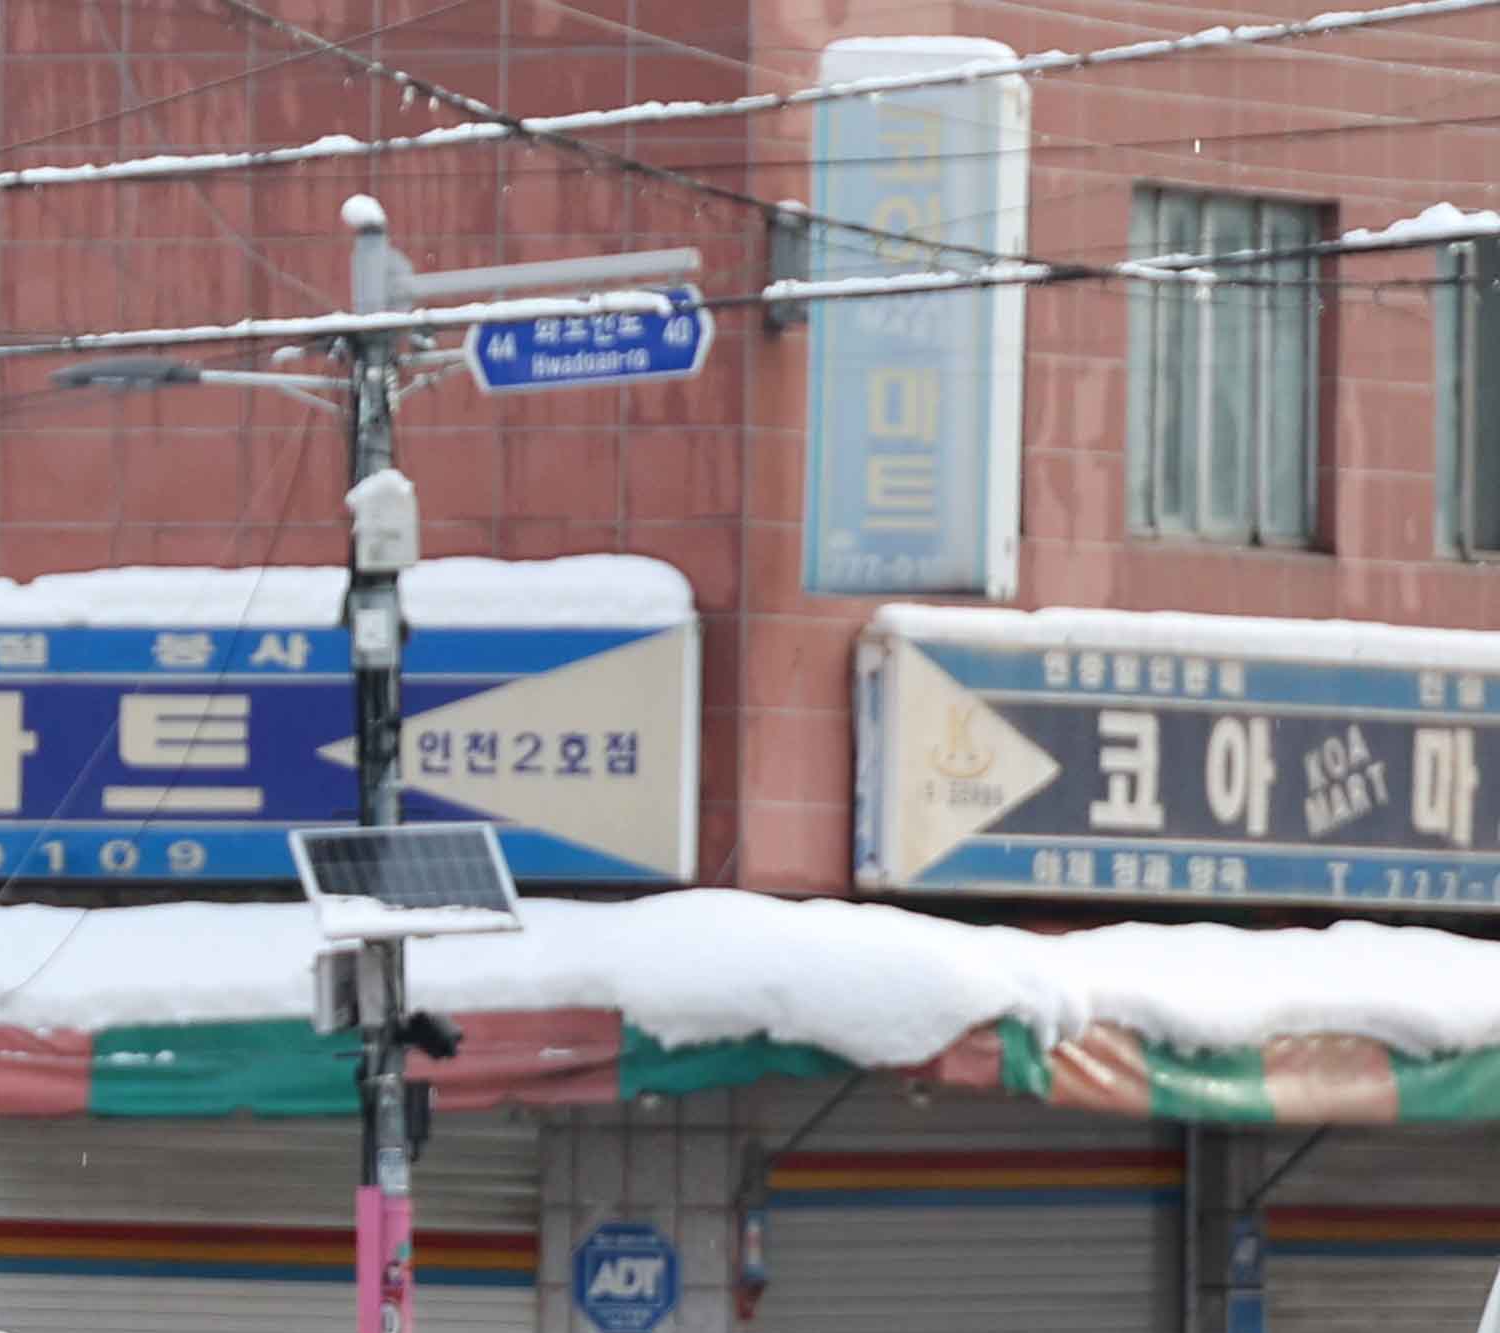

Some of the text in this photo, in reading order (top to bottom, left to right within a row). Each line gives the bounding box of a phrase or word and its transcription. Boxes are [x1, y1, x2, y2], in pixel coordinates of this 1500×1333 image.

[417, 730, 640, 776] 인천2호점
[1089, 709, 1275, 836] 코아
[1303, 723, 1370, 788] KOA
[1412, 726, 1500, 848] 마
[1304, 759, 1388, 838] MART
[587, 1256, 665, 1297] ADT
